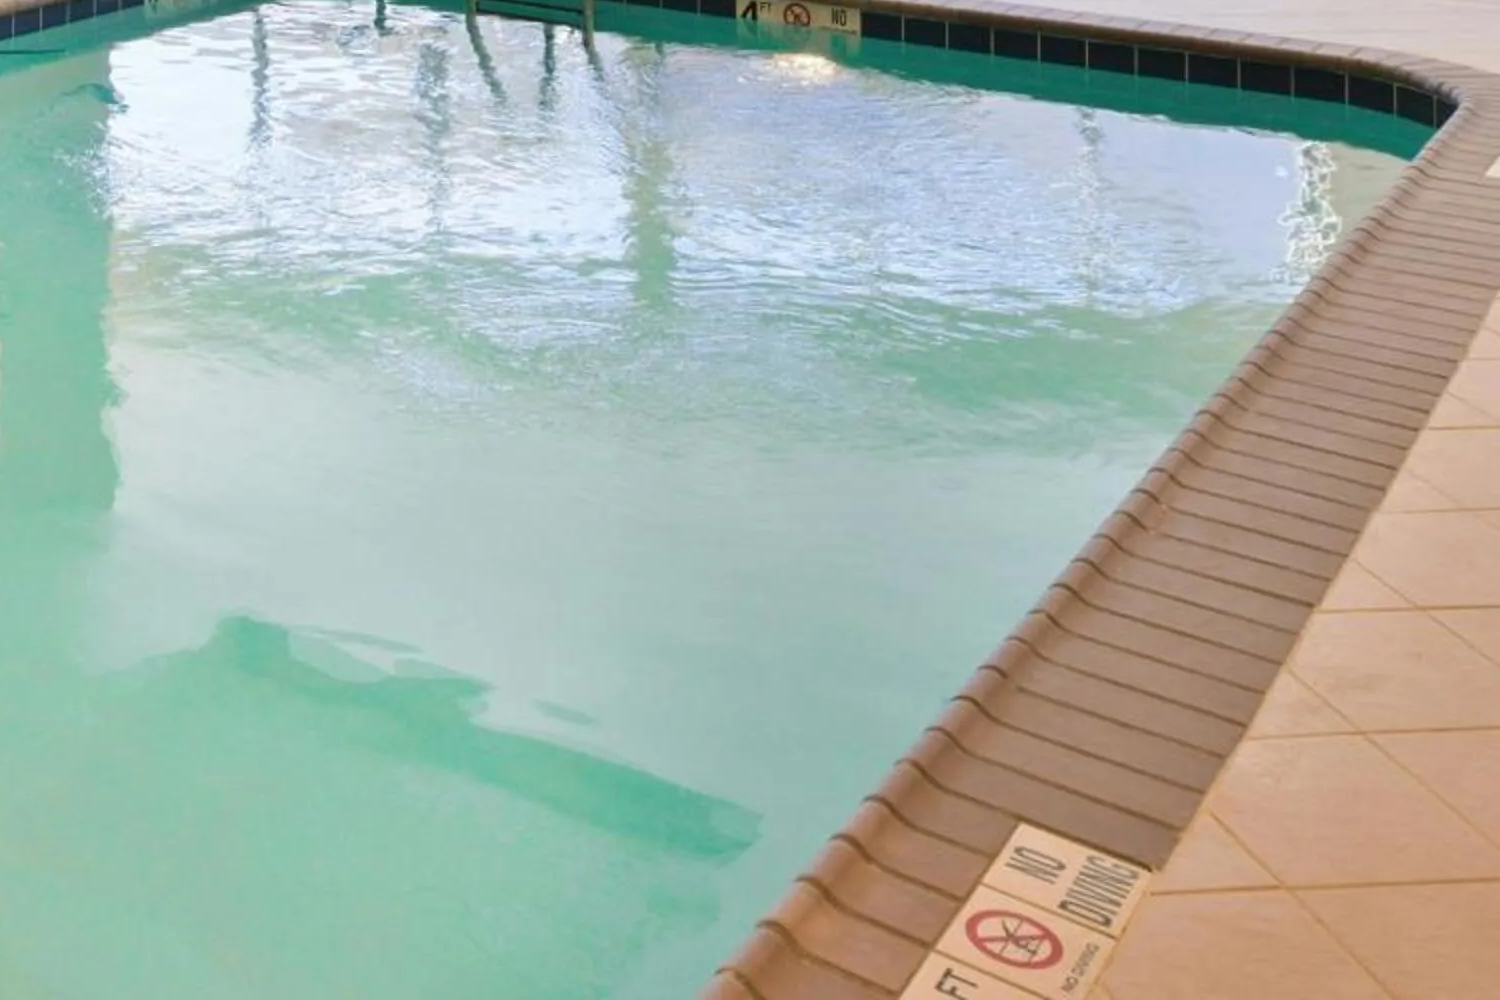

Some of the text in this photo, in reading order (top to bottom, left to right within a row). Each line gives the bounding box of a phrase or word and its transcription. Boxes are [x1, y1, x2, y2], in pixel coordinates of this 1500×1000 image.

[760, 2, 772, 13] FT
[831, 8, 847, 26] NO
[1004, 846, 1067, 885] NO
[1058, 855, 1139, 928] DIVING
